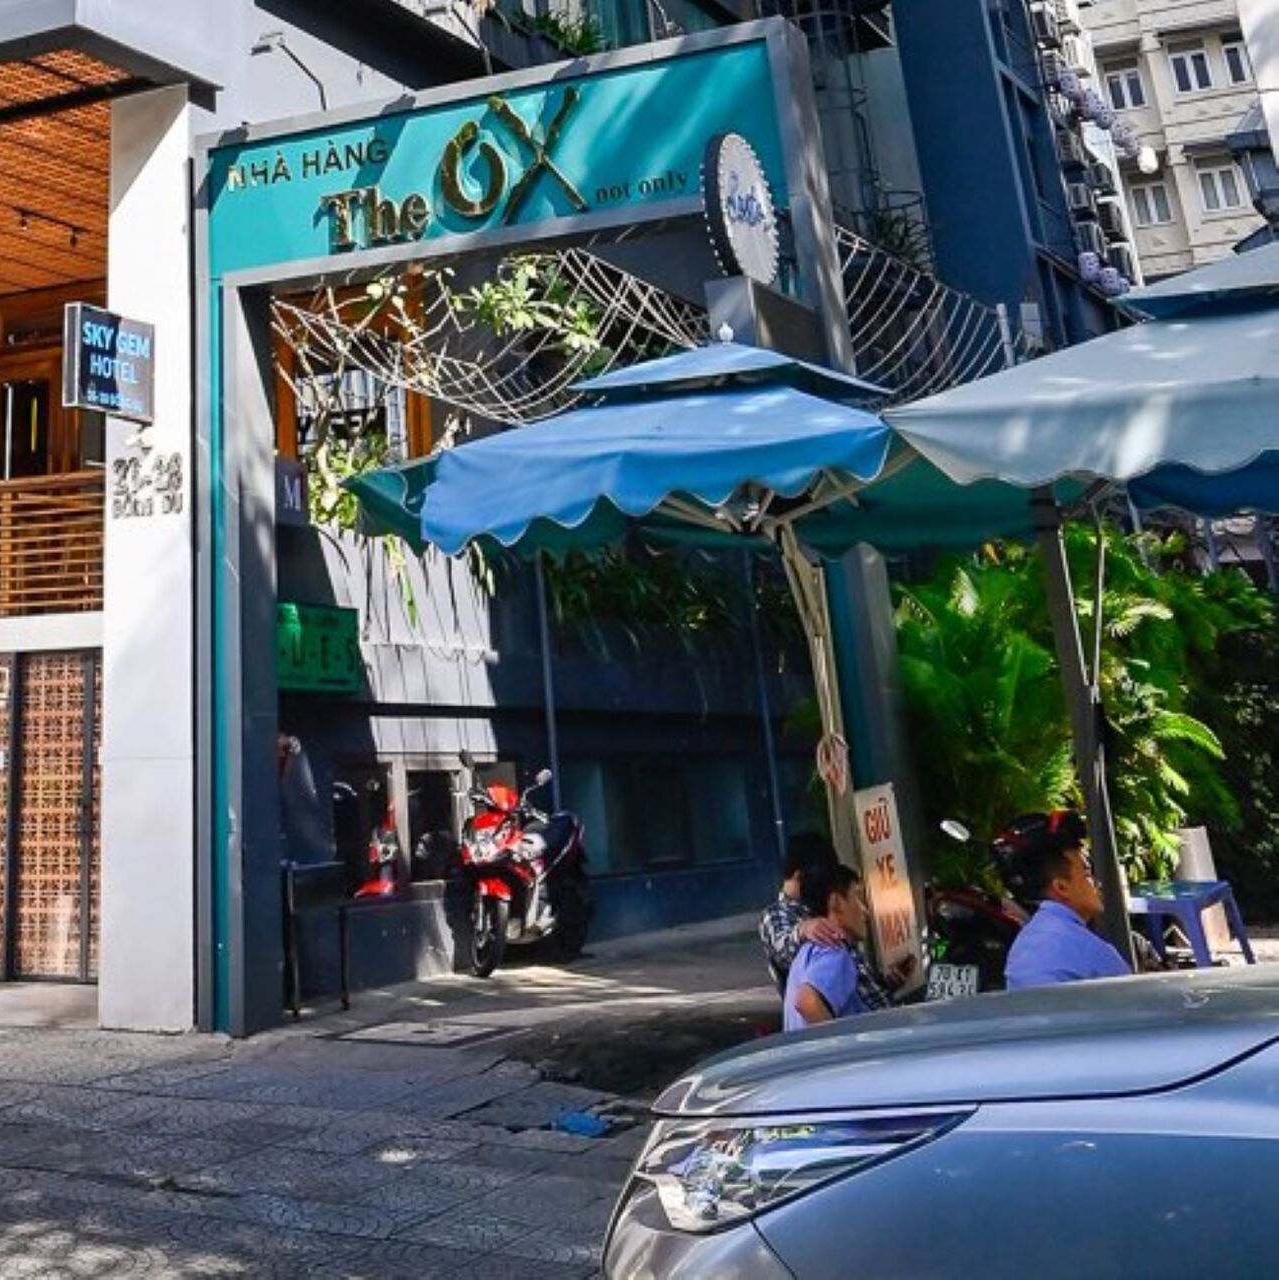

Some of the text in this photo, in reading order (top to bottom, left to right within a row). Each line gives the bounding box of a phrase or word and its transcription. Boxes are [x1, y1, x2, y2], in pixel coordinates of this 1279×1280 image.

[227, 138, 386, 190] NHÀ HÀNG
[638, 169, 687, 194] only
[320, 185, 428, 250] The
[81, 320, 151, 360] SKY GEM
[89, 352, 138, 385] HOTEL
[876, 853, 898, 888] XE
